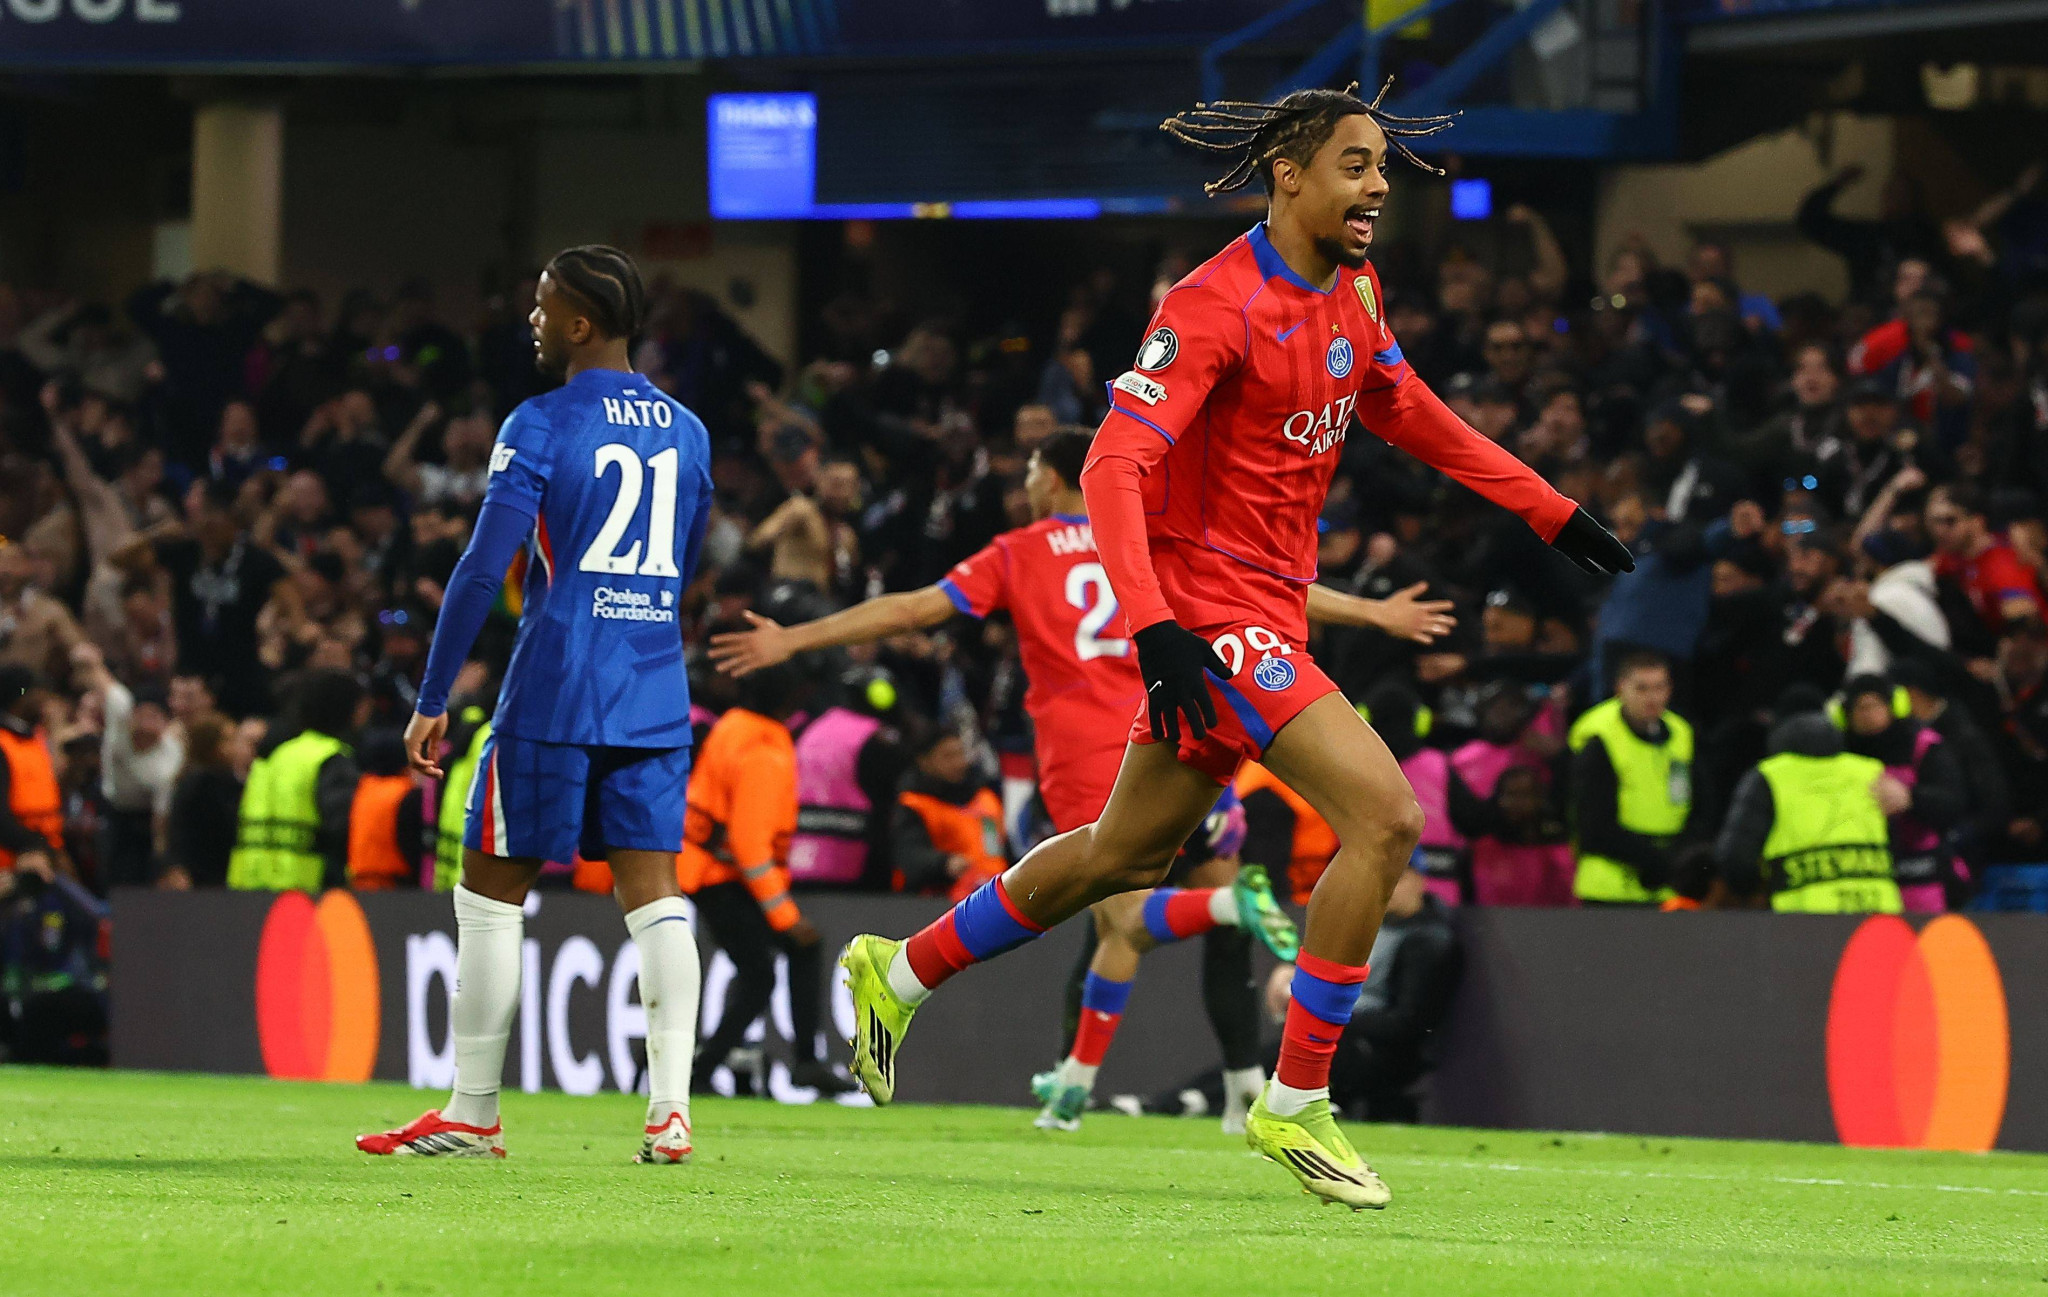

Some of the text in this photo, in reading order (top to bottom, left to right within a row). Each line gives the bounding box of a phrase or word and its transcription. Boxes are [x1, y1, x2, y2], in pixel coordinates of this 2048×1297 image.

[602, 397, 672, 429] HATO
[578, 442, 680, 578] 21
[593, 586, 651, 606] Chelsea
[592, 602, 674, 623] Foundation
